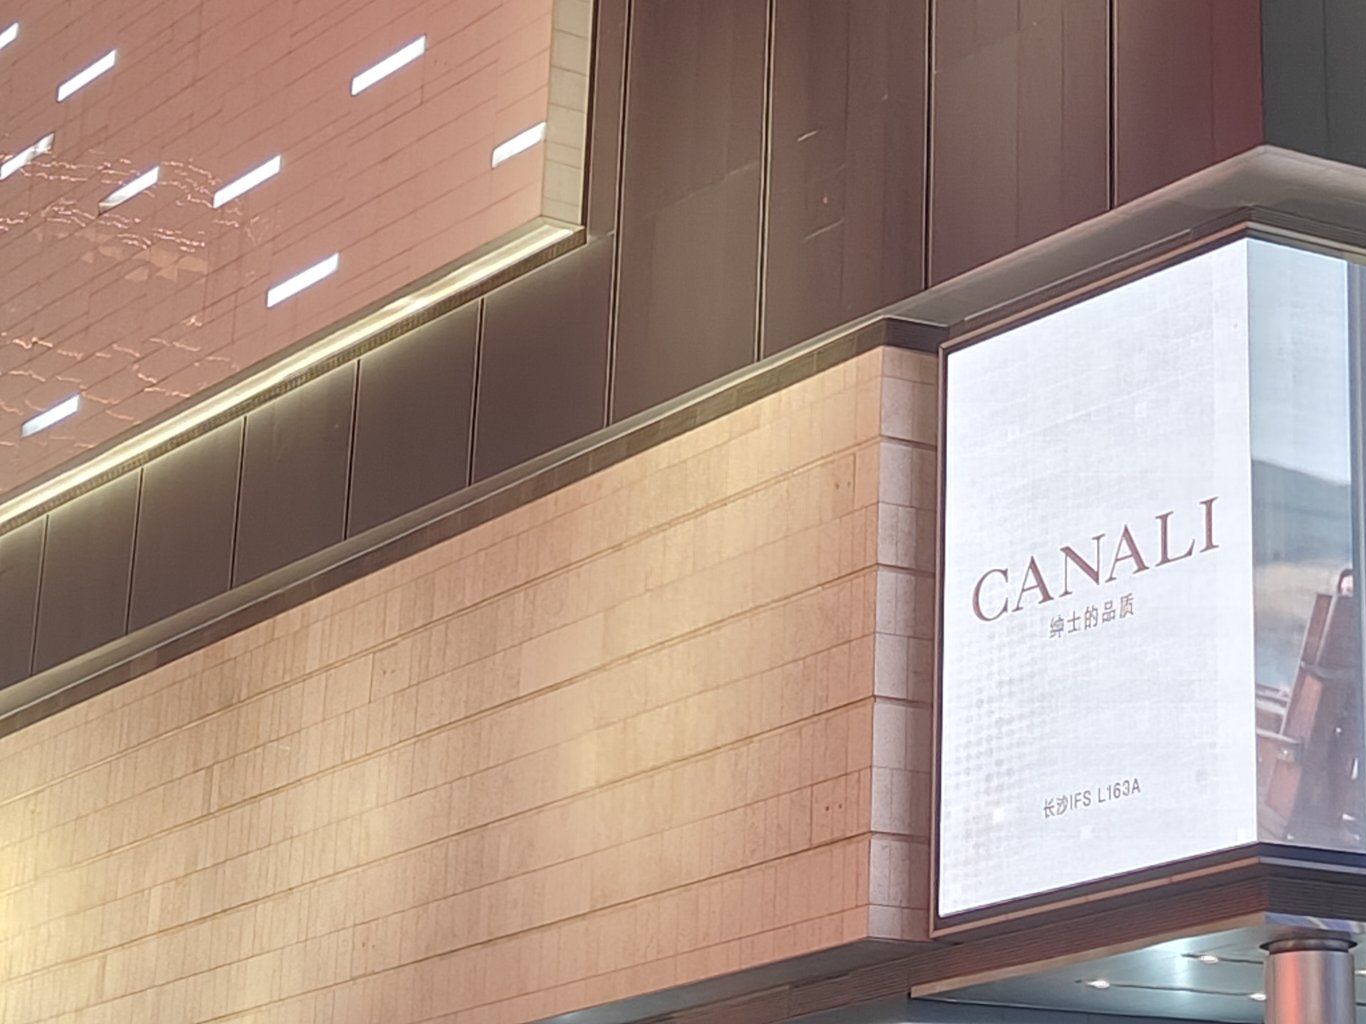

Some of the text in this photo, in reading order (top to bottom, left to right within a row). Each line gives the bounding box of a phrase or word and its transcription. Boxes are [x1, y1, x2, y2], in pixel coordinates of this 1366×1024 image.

[971, 495, 1220, 623] CANALI
[1049, 592, 1135, 639] 绅士的品质
